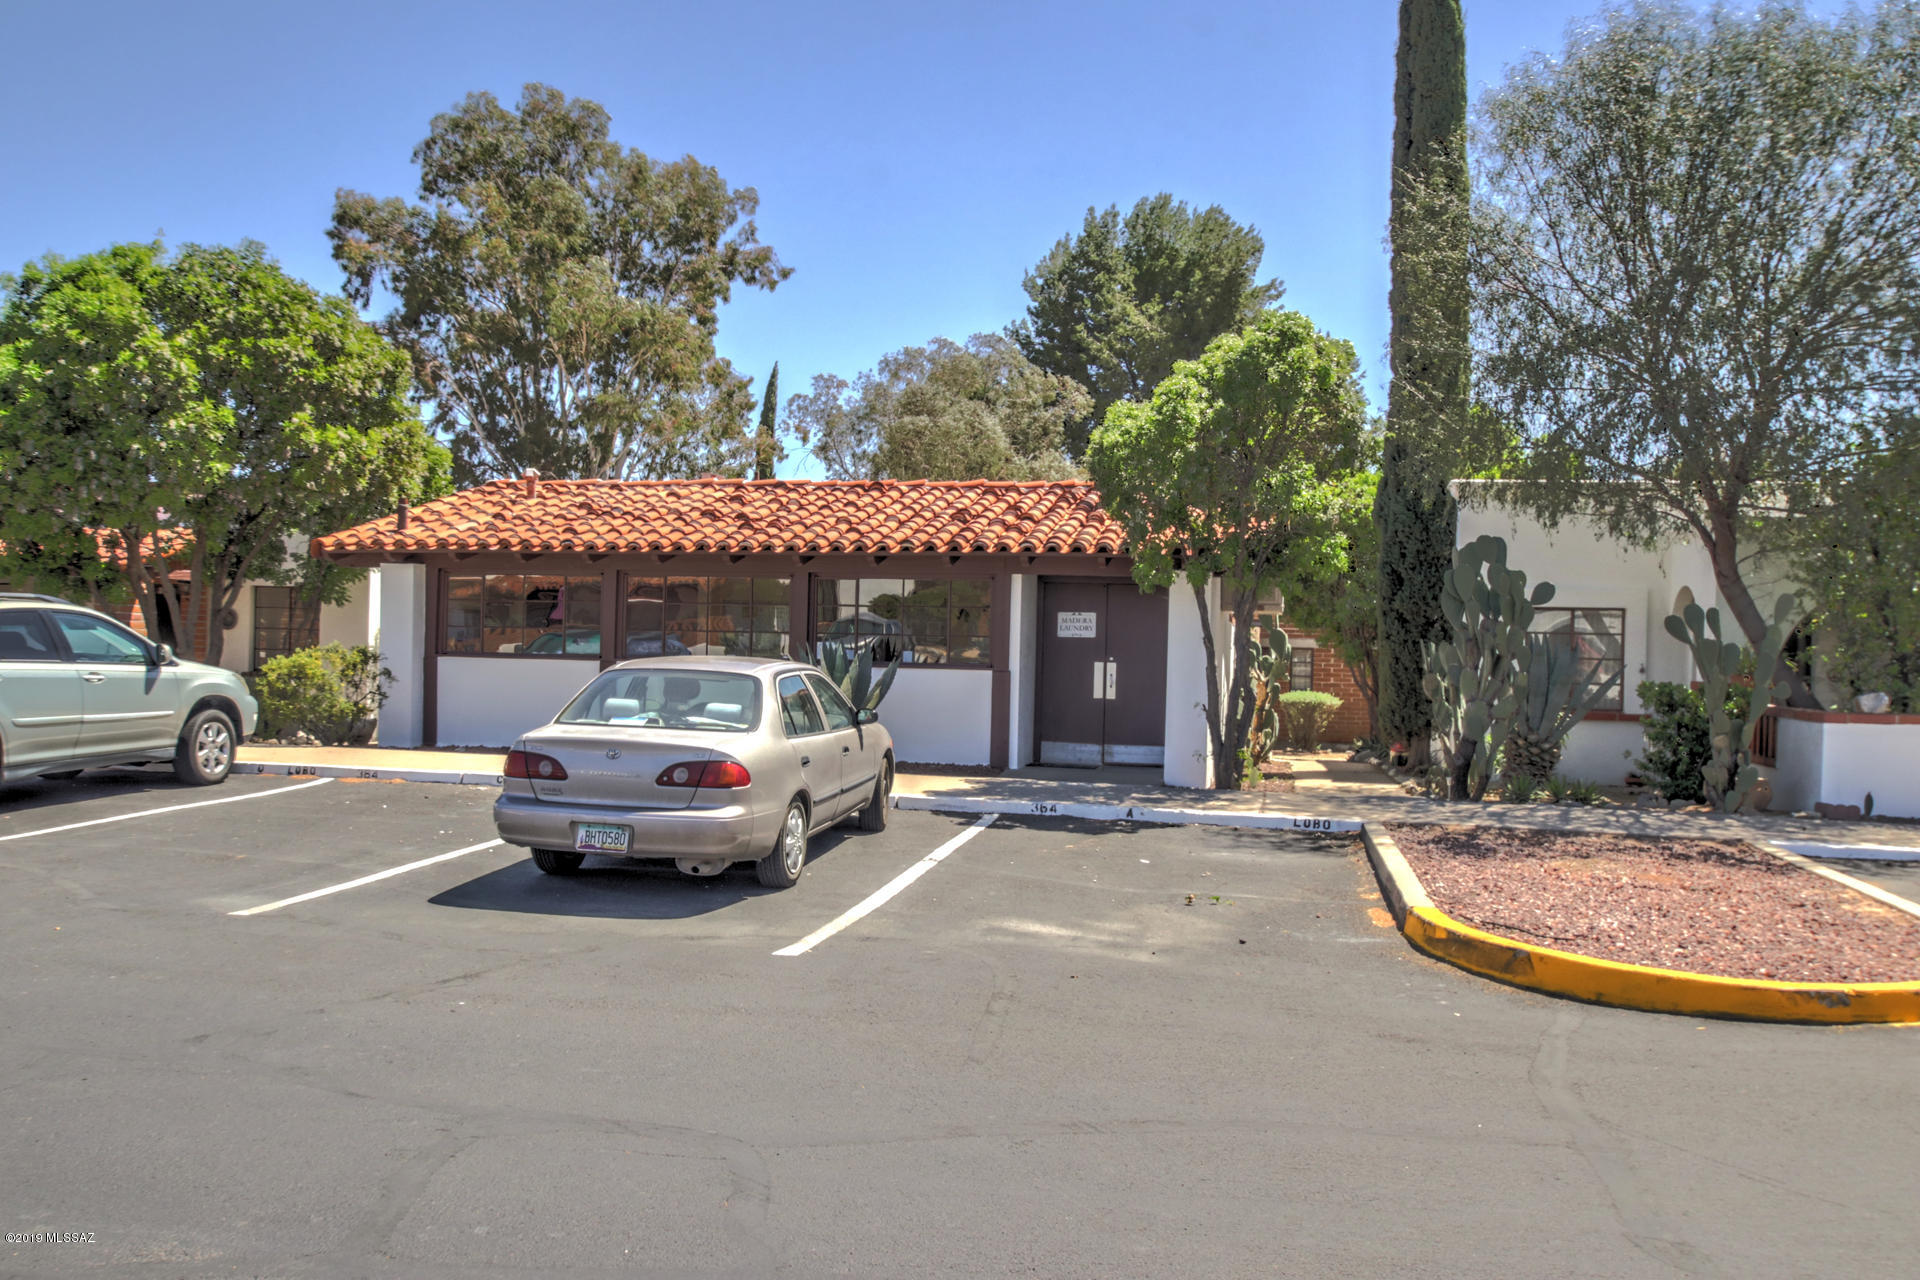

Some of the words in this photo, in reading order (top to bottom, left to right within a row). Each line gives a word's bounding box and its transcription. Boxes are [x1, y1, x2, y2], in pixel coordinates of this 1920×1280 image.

[1126, 807, 1134, 819] A
[1293, 818, 1331, 830] LOBO
[584, 829, 626, 846] BHT0580
